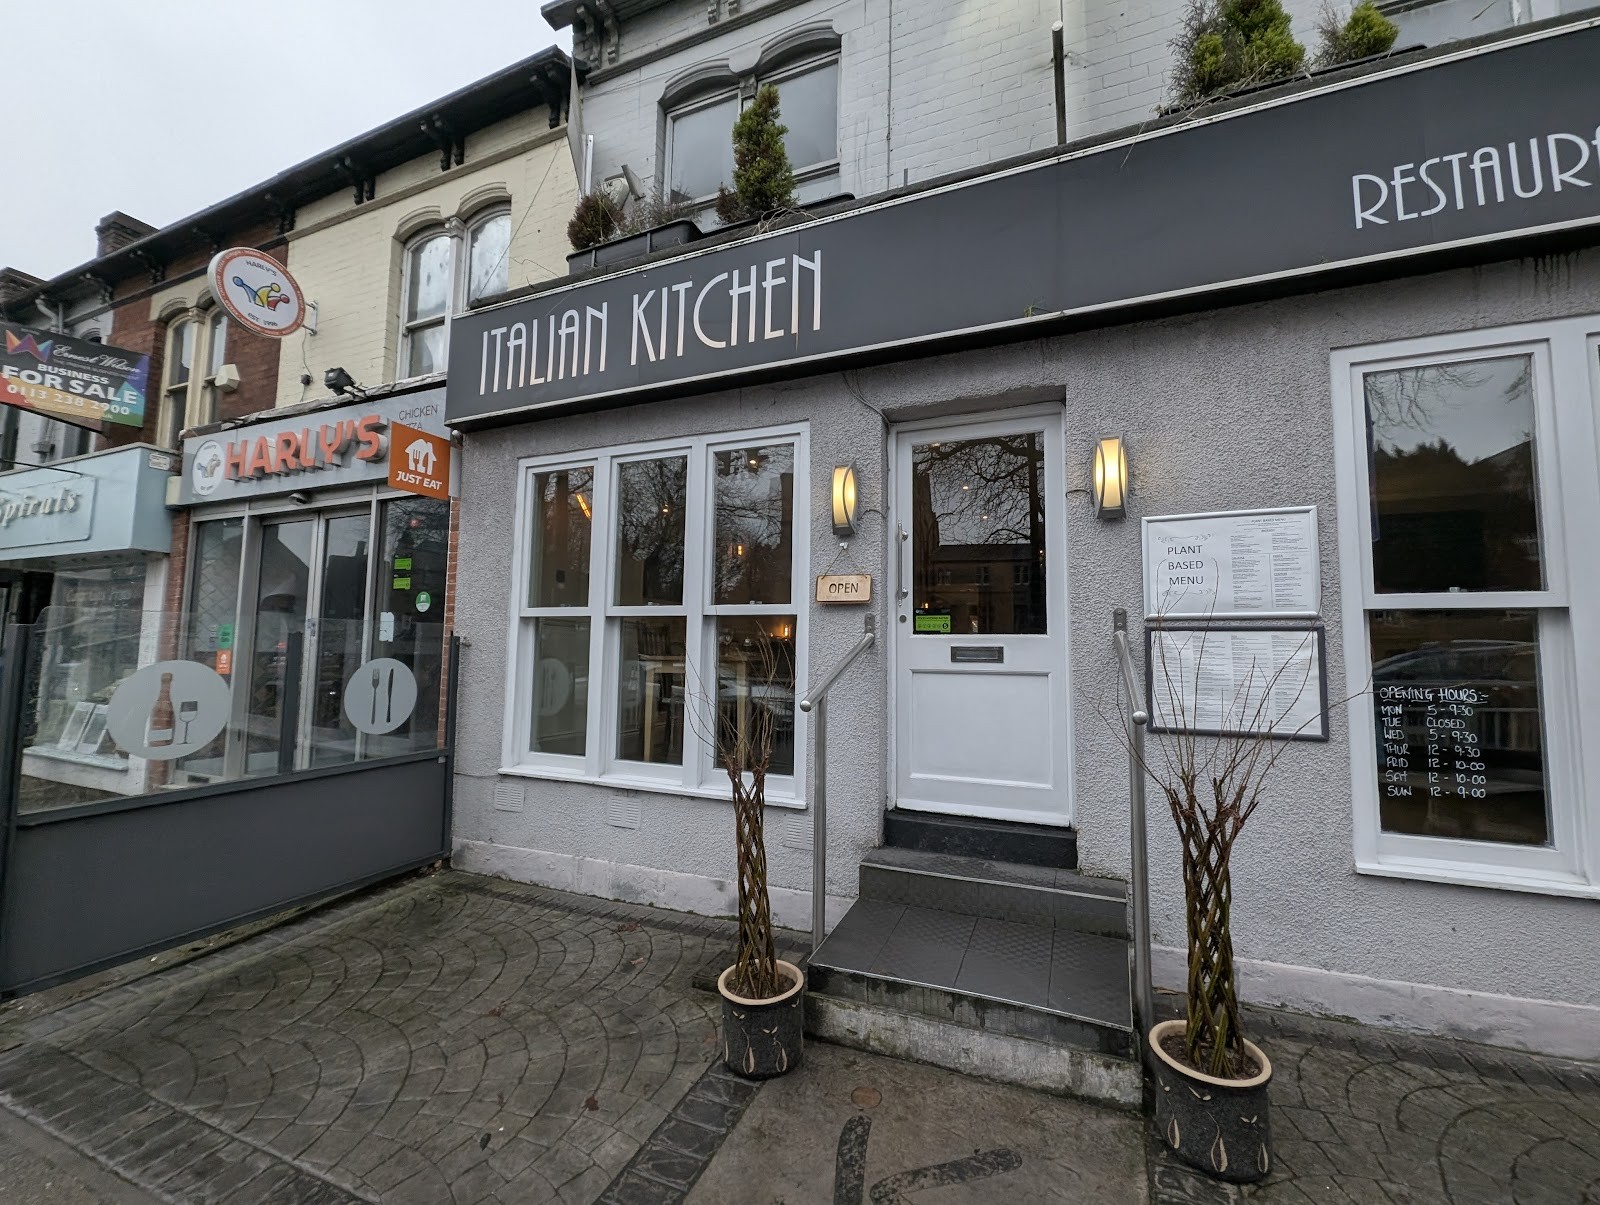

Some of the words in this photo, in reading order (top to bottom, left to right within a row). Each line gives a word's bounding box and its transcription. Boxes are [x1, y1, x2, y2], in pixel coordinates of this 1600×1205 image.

[1352, 125, 1600, 229] RESTAUR
[479, 301, 608, 396] ITALIAN
[630, 250, 822, 366] KITCHEN
[37, 363, 109, 384] BUSINESS
[2, 364, 63, 390] FOR
[68, 380, 138, 405] SALE
[6, 384, 48, 400] 0113
[55, 393, 84, 407] 238
[91, 401, 130, 415] 2900
[398, 404, 439, 420] CHICKEN
[224, 414, 384, 480] HARLY'S
[396, 471, 422, 485] JUST
[423, 477, 442, 490] EAT
[0, 488, 78, 528] pirals
[1167, 545, 1203, 555] PLANT
[1168, 560, 1204, 571] BASED
[1169, 576, 1204, 585] MENU
[829, 583, 859, 594] OPEN
[1380, 686, 1434, 701] OPENING
[1381, 704, 1402, 716] MON
[1427, 705, 1437, 716] 5
[1382, 717, 1402, 727] TUE
[1426, 717, 1465, 728] CLOSED
[1384, 728, 1404, 739] WED
[1429, 729, 1438, 740] 5
[1384, 743, 1410, 755] THUR
[1428, 744, 1440, 755] 12
[1386, 757, 1408, 768] FRID
[1428, 758, 1440, 768] 12
[1428, 772, 1439, 783] 12
[1387, 785, 1412, 796] SUN
[1430, 786, 1442, 796] 12
